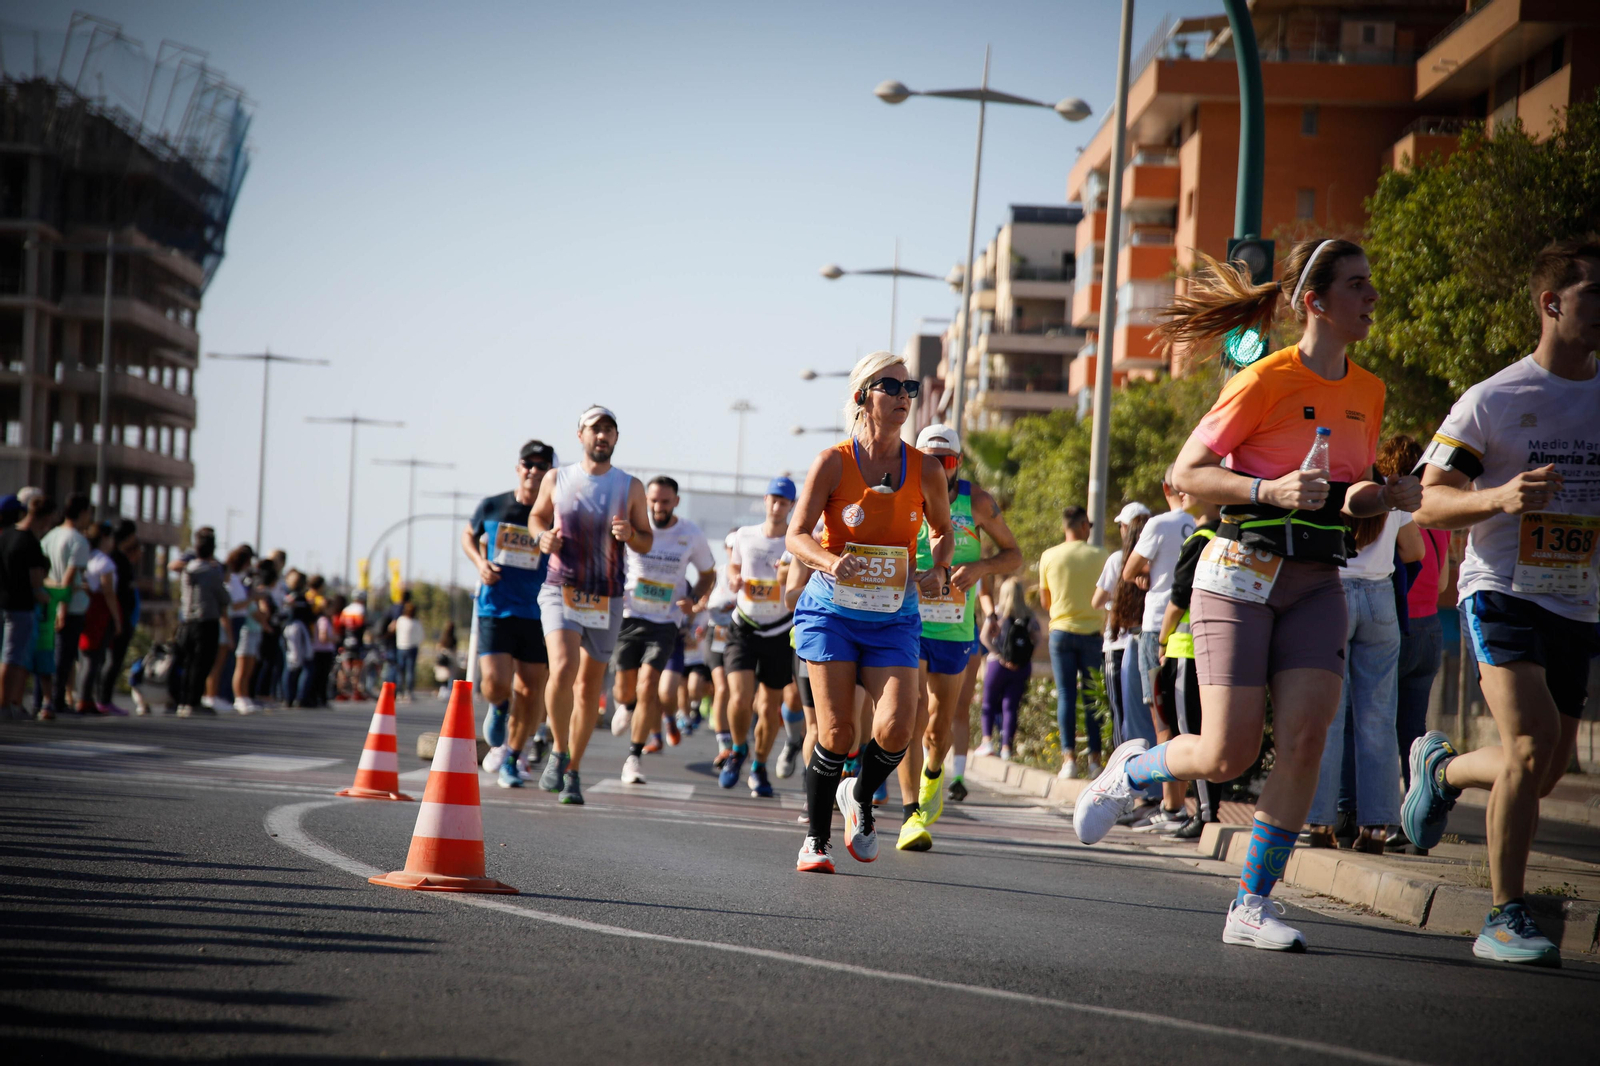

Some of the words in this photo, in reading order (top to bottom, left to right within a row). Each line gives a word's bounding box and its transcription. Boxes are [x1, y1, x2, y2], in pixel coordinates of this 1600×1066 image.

[1528, 439, 1569, 450] Medio
[1527, 451, 1584, 465] Almería
[1531, 526, 1594, 553] 1368
[1531, 551, 1552, 559] JUAN
